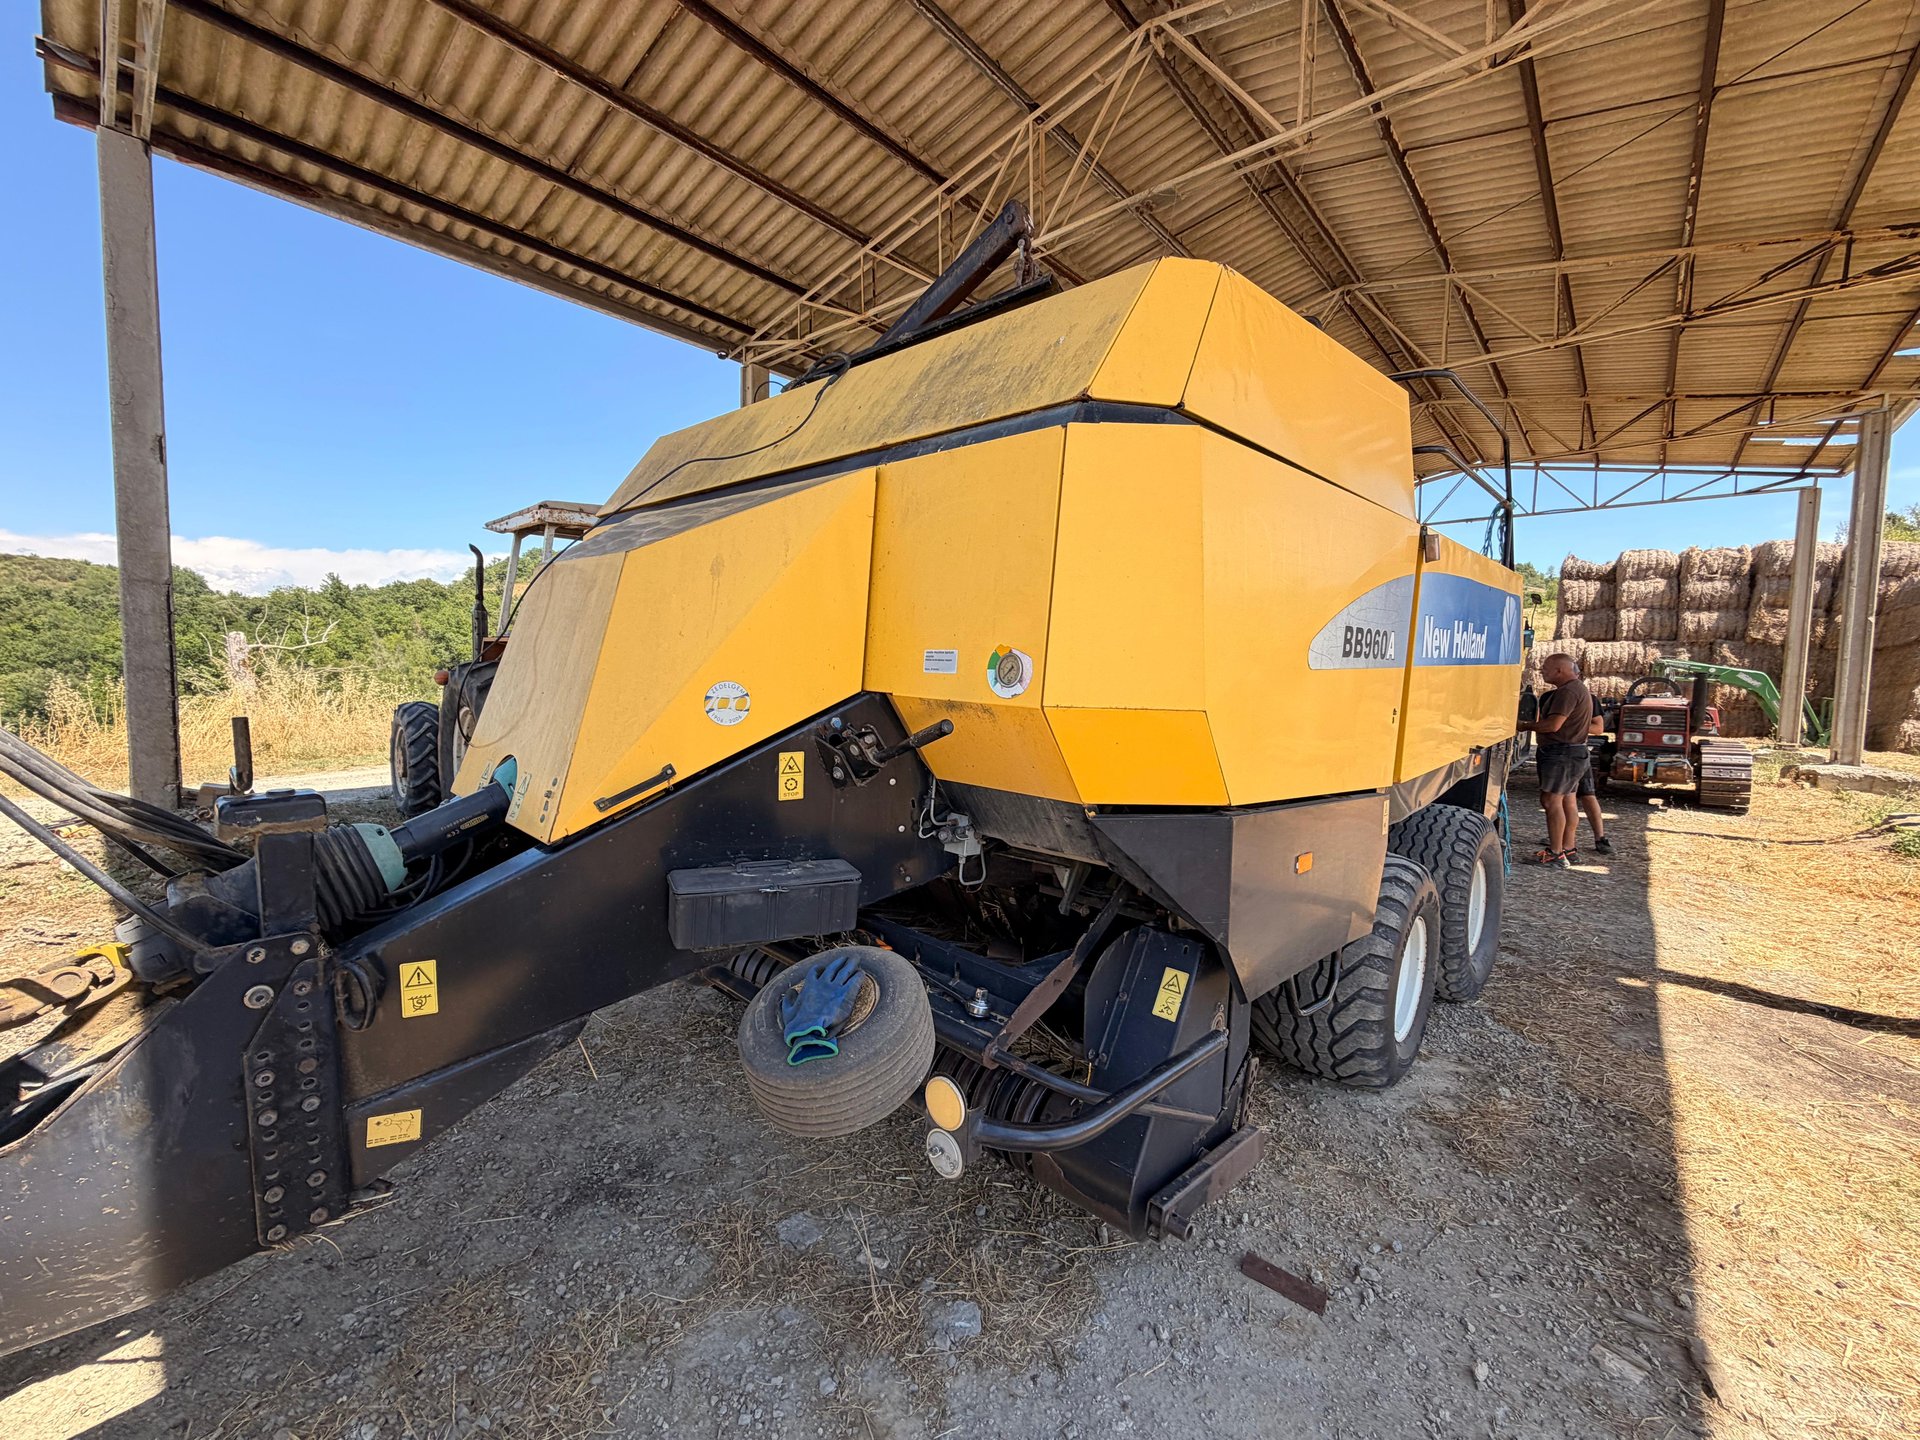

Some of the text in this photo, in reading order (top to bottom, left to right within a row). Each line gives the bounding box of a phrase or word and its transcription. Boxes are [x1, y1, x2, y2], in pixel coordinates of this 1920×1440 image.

[1341, 625, 1395, 661] BB960A
[1422, 615, 1488, 660] New Holland
[711, 683, 745, 694] ZEDELGEM
